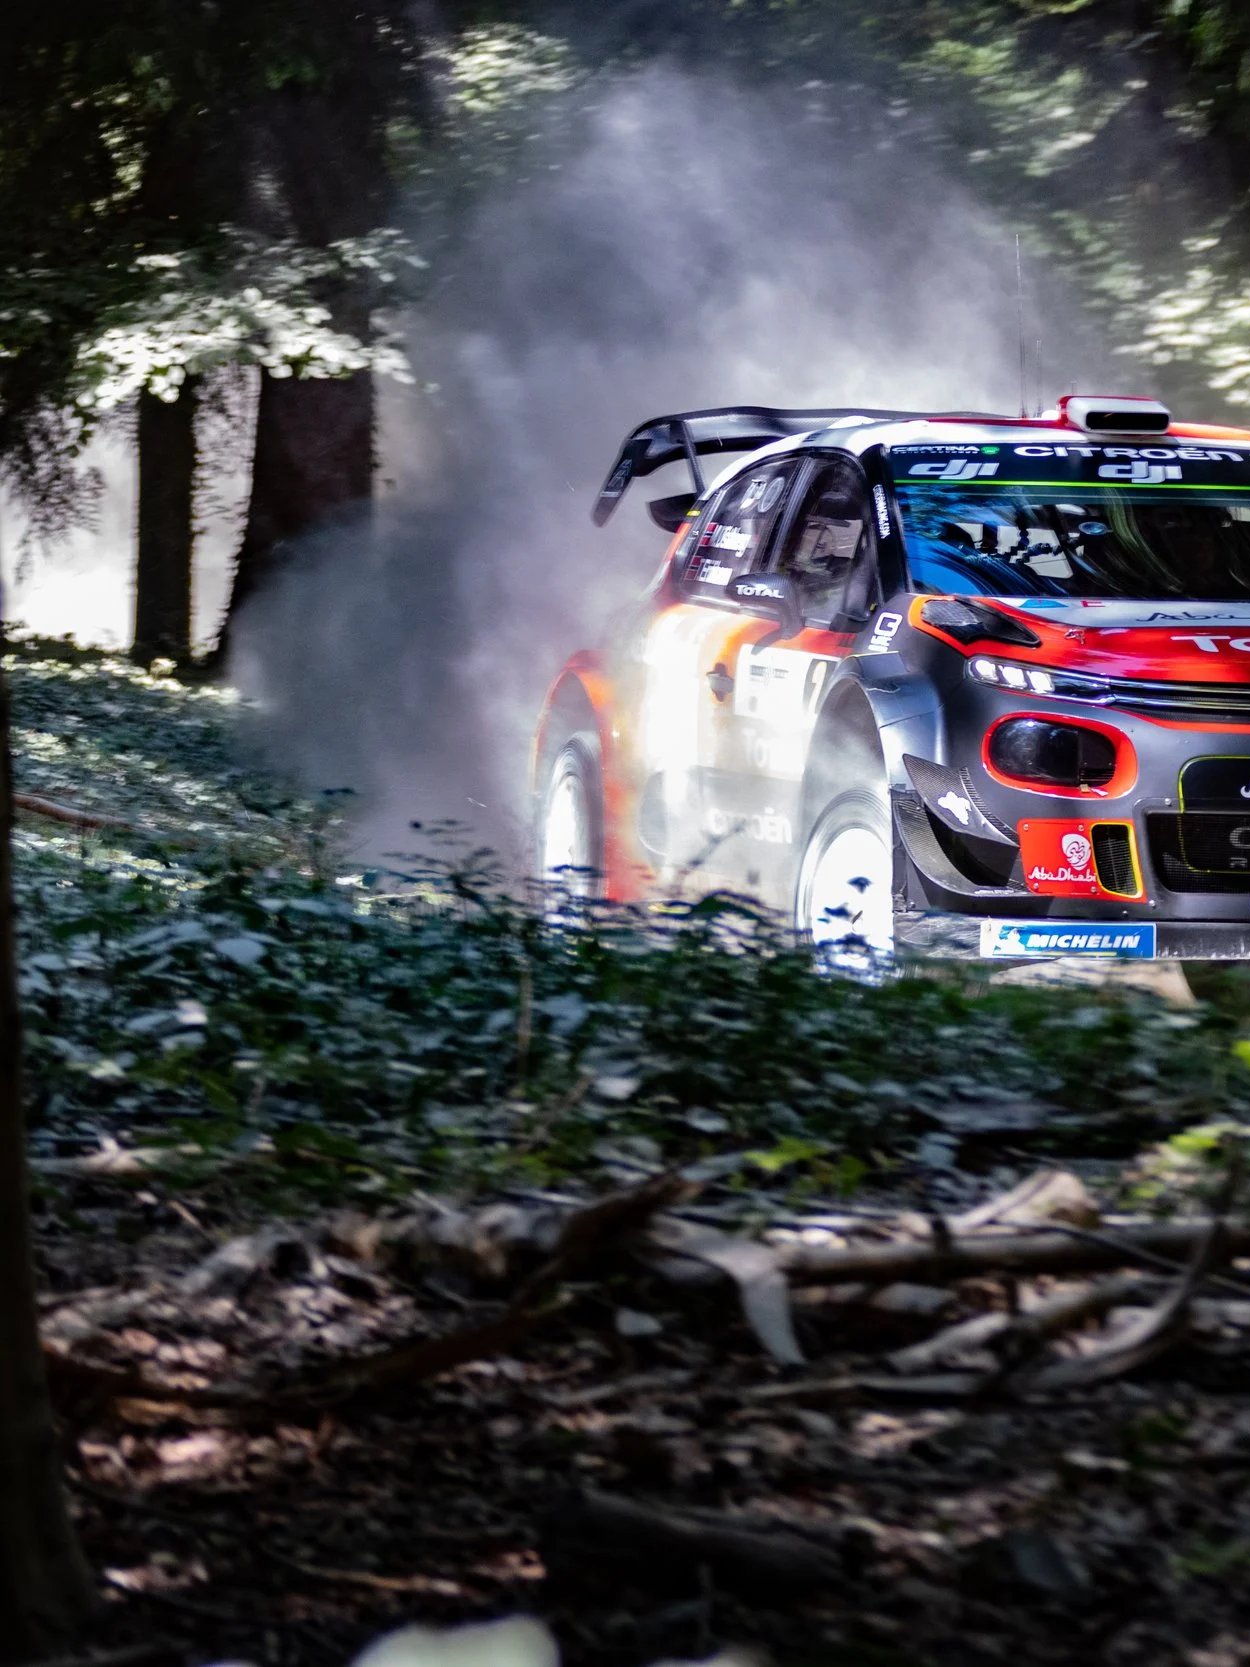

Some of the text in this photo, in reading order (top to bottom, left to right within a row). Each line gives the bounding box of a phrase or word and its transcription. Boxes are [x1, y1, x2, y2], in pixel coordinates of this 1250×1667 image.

[1013, 446, 1244, 462] CITROËN
[735, 584, 785, 599] TOTAL
[1026, 934, 1141, 949] MICHELIN
